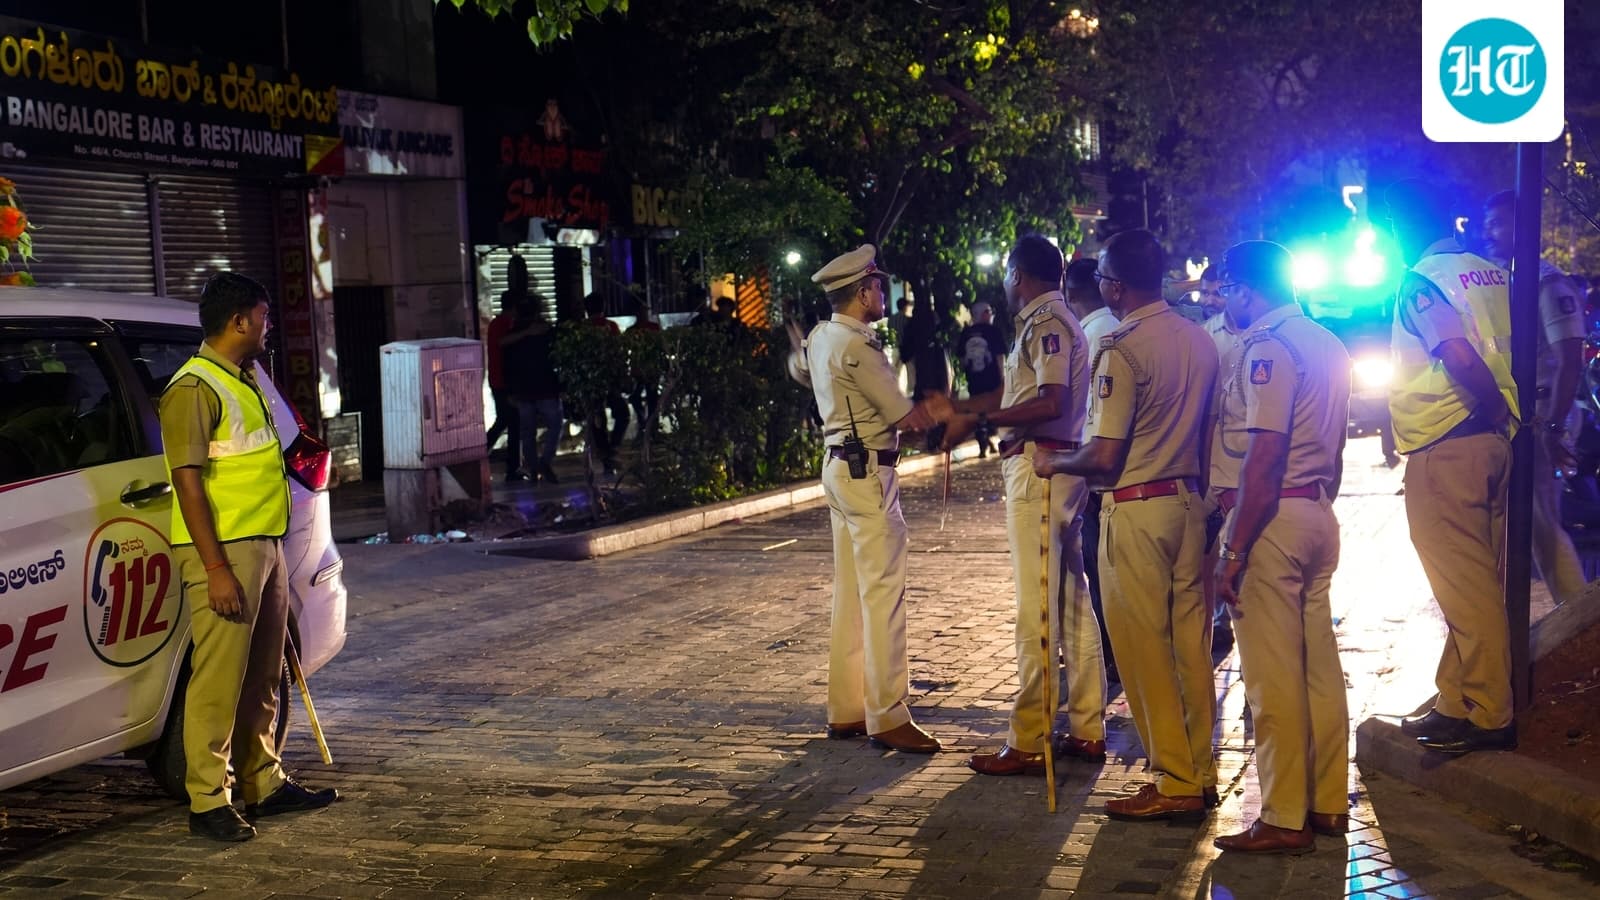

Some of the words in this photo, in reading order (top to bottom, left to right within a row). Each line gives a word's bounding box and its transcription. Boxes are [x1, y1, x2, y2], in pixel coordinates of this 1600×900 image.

[136, 58, 200, 103] ಬಾರ್
[203, 75, 218, 105] &
[7, 96, 132, 139] BANGALORE
[139, 116, 176, 146] BAR
[183, 122, 195, 147] &
[200, 123, 303, 159] RESTAURANT
[112, 149, 142, 160] Church
[1459, 269, 1505, 289] POLICE
[120, 536, 148, 556] ನಮ್ಮ
[104, 552, 171, 646] 112
[96, 606, 111, 645] Namma
